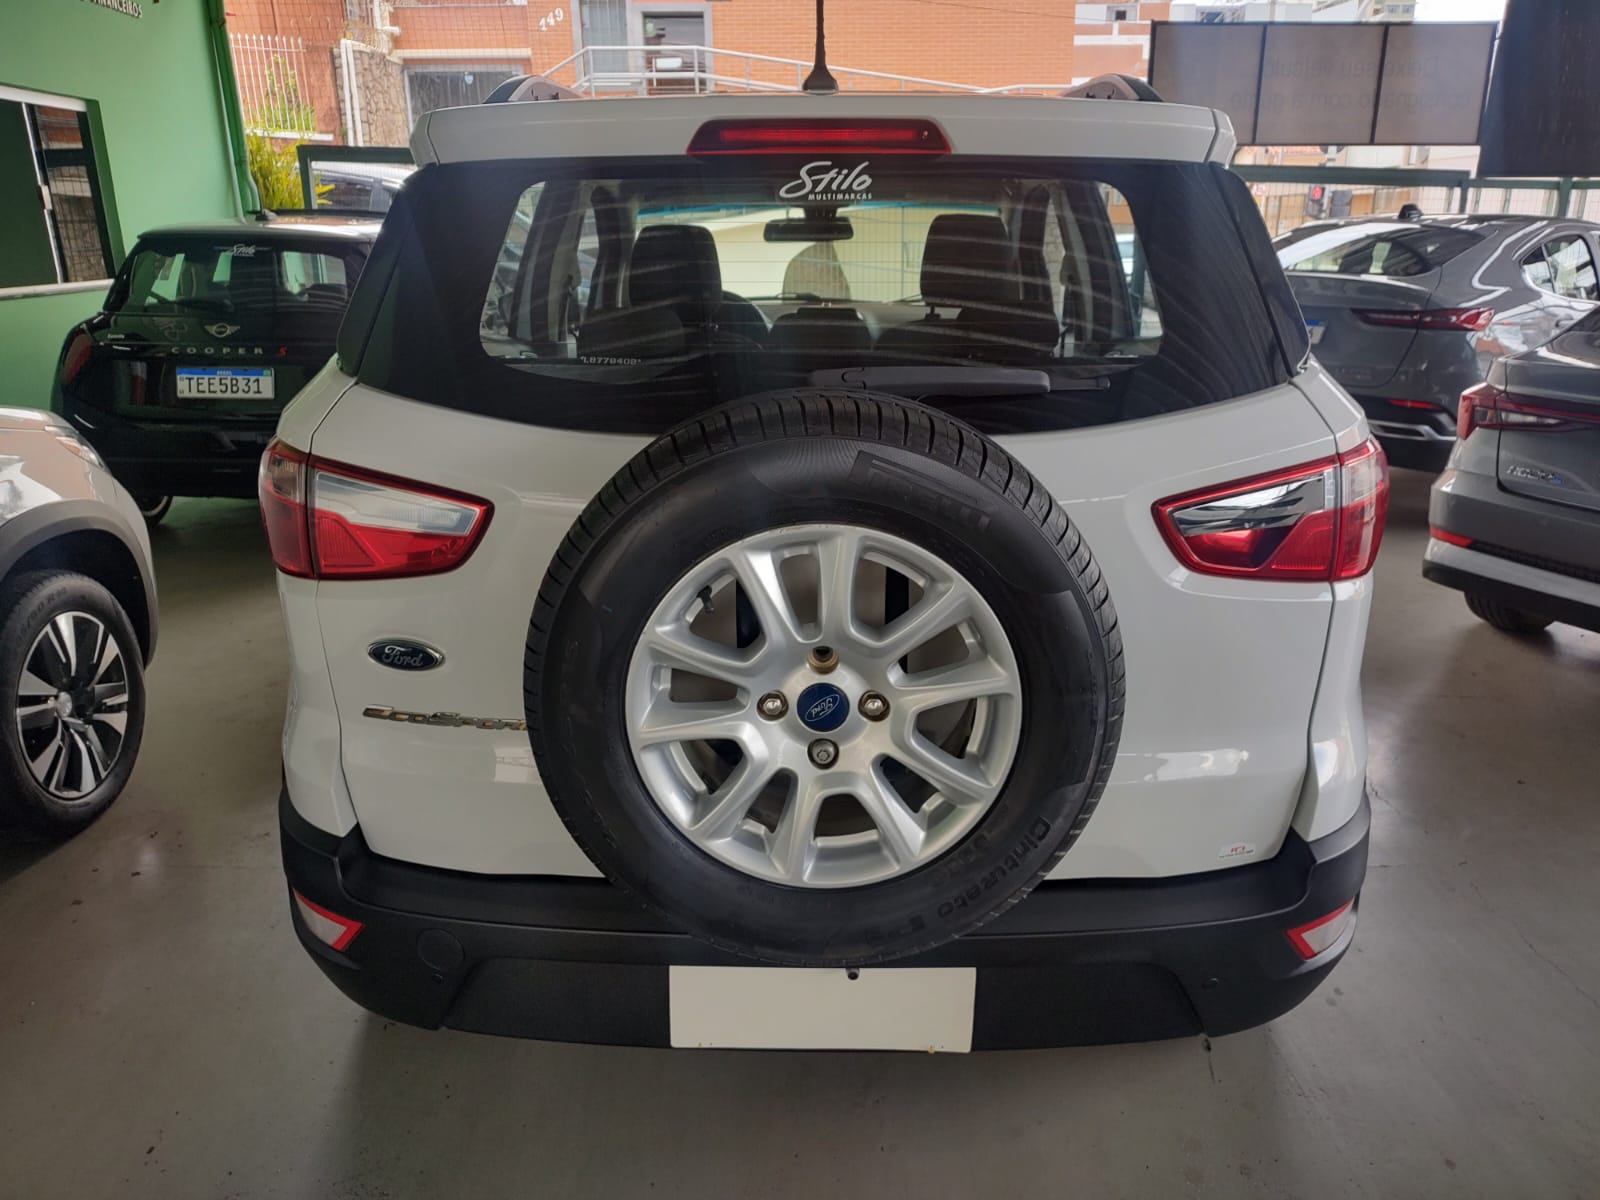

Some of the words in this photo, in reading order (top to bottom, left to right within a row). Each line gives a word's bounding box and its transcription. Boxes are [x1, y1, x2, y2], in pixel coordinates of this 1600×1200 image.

[93, 0, 143, 18] ANCEIROS
[778, 161, 873, 199] Stilo
[807, 193, 873, 201] MULTIMARCAS
[171, 346, 263, 354] COOPER
[278, 345, 287, 357] S
[185, 376, 263, 394] TEE5B31
[382, 644, 424, 667] Ford
[810, 696, 834, 718] Ford
